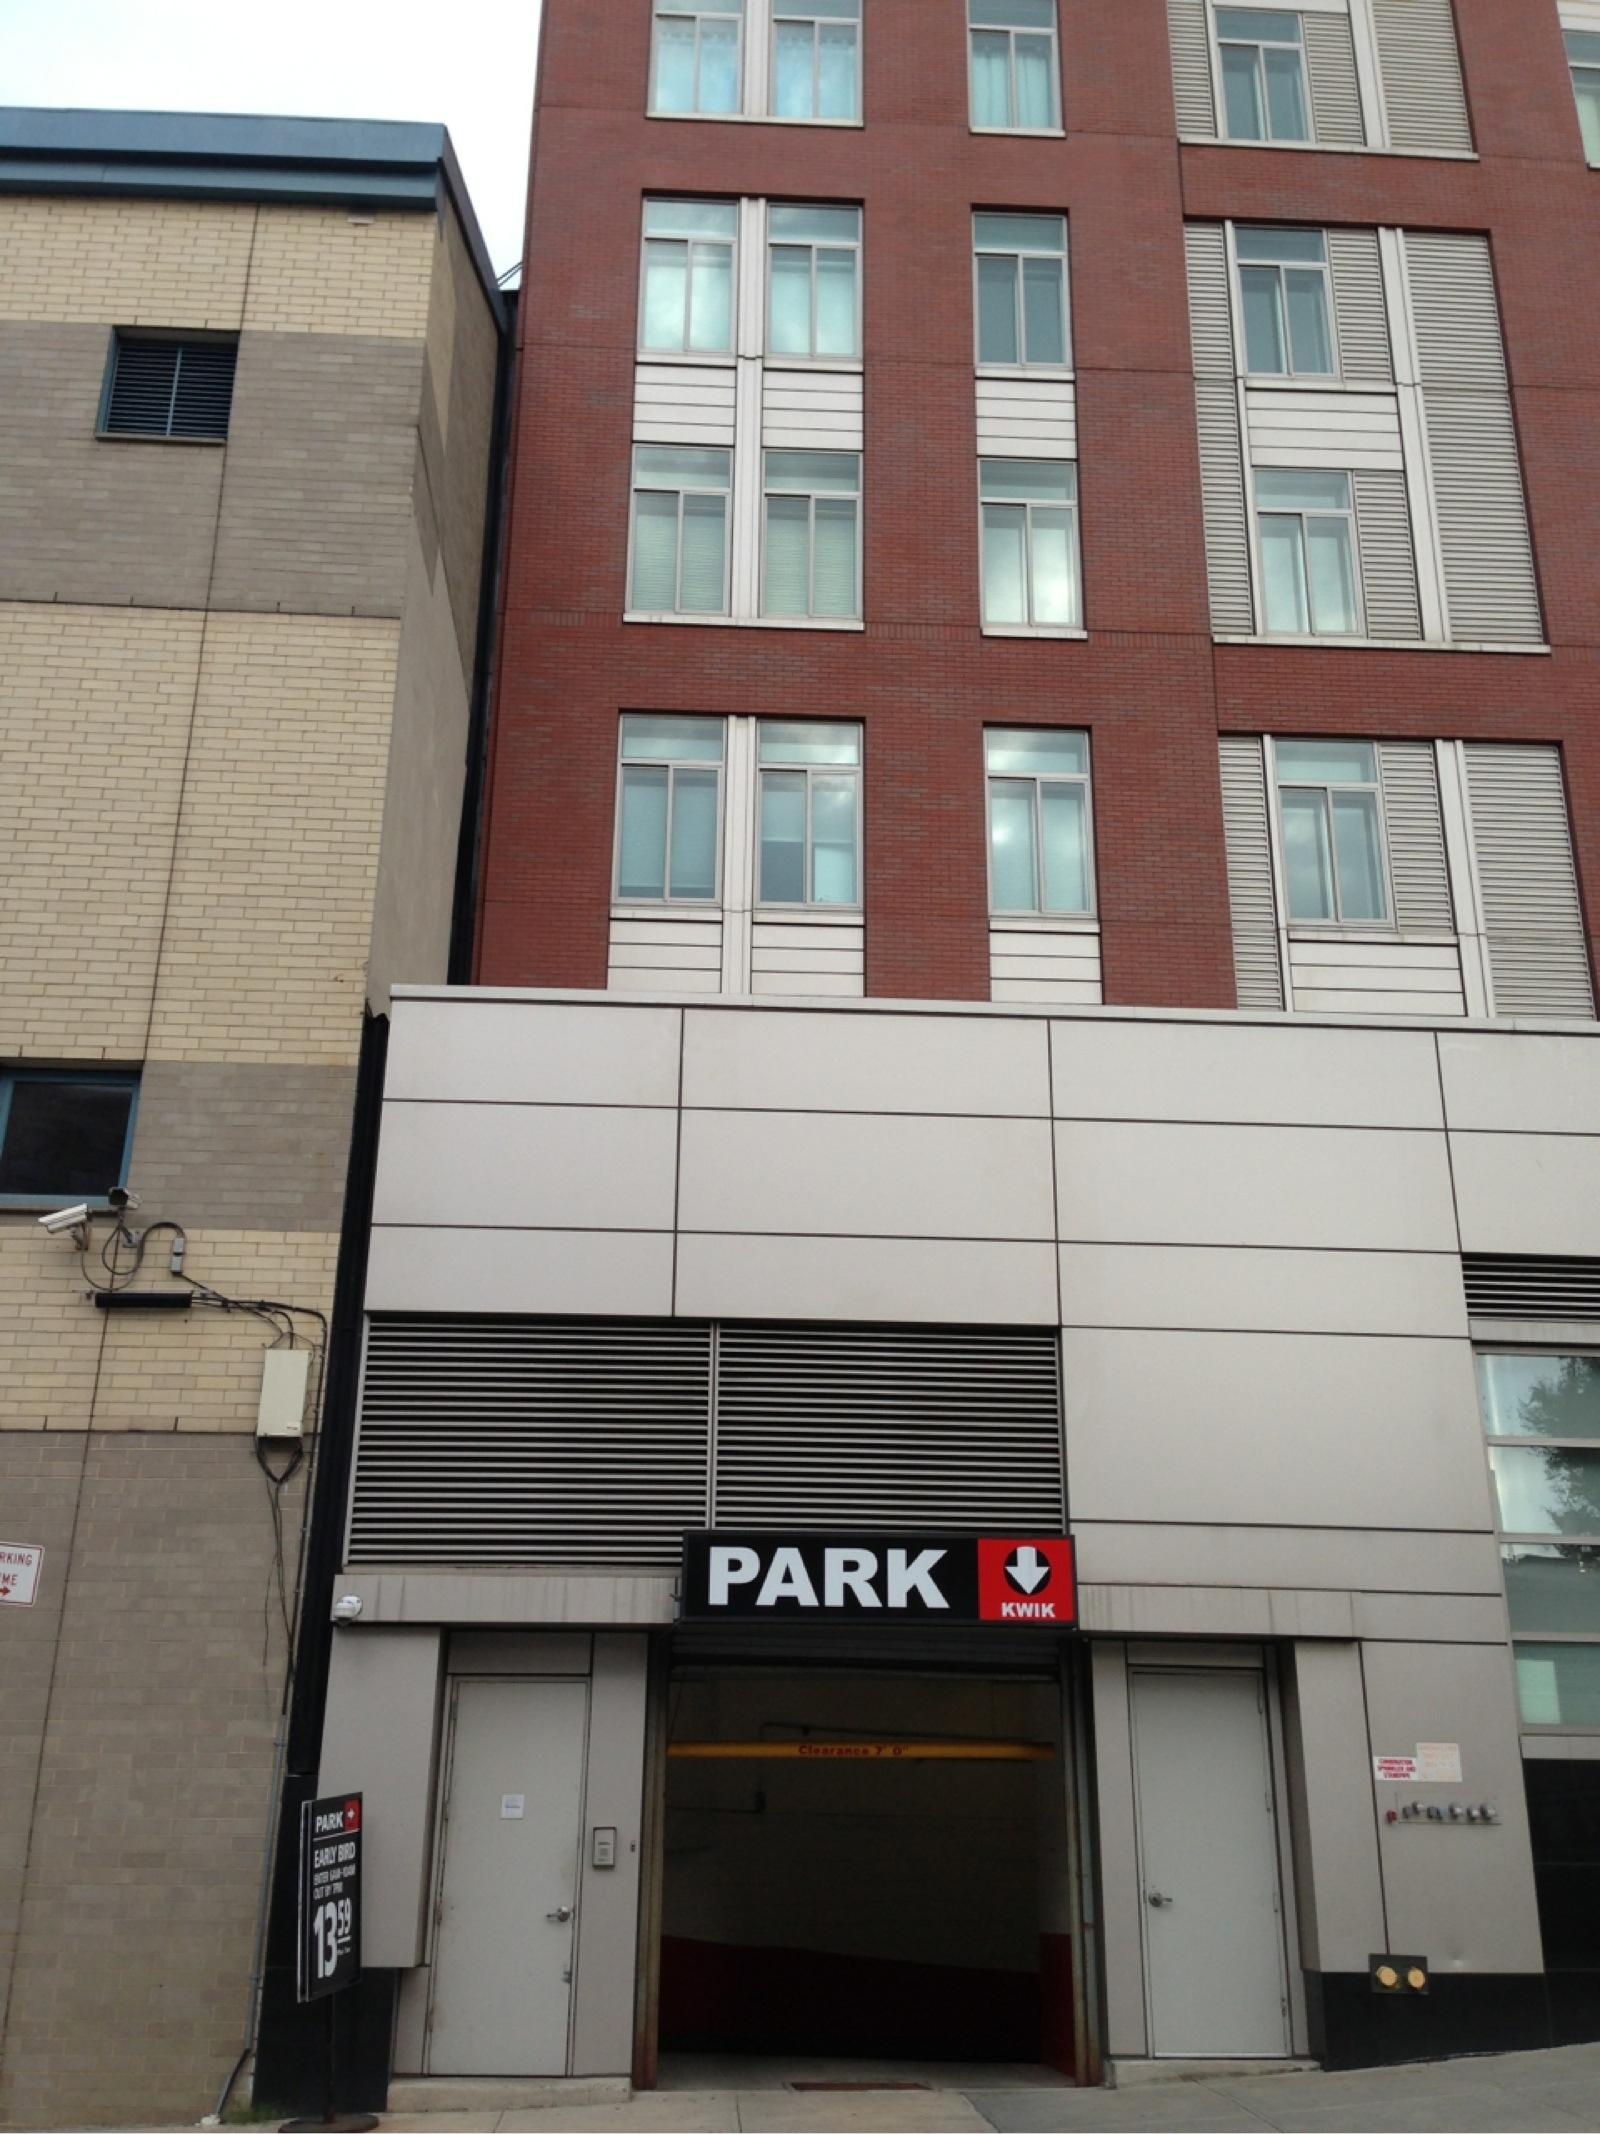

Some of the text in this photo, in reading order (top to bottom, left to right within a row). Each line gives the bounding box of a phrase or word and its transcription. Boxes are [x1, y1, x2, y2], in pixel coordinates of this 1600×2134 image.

[708, 1546, 950, 1609] PARK
[1001, 1602, 1056, 1618] KWIK
[798, 1744, 870, 1756] Clearance
[315, 1811, 344, 1834] PARK
[314, 1842, 356, 1869] EARLY BIRD
